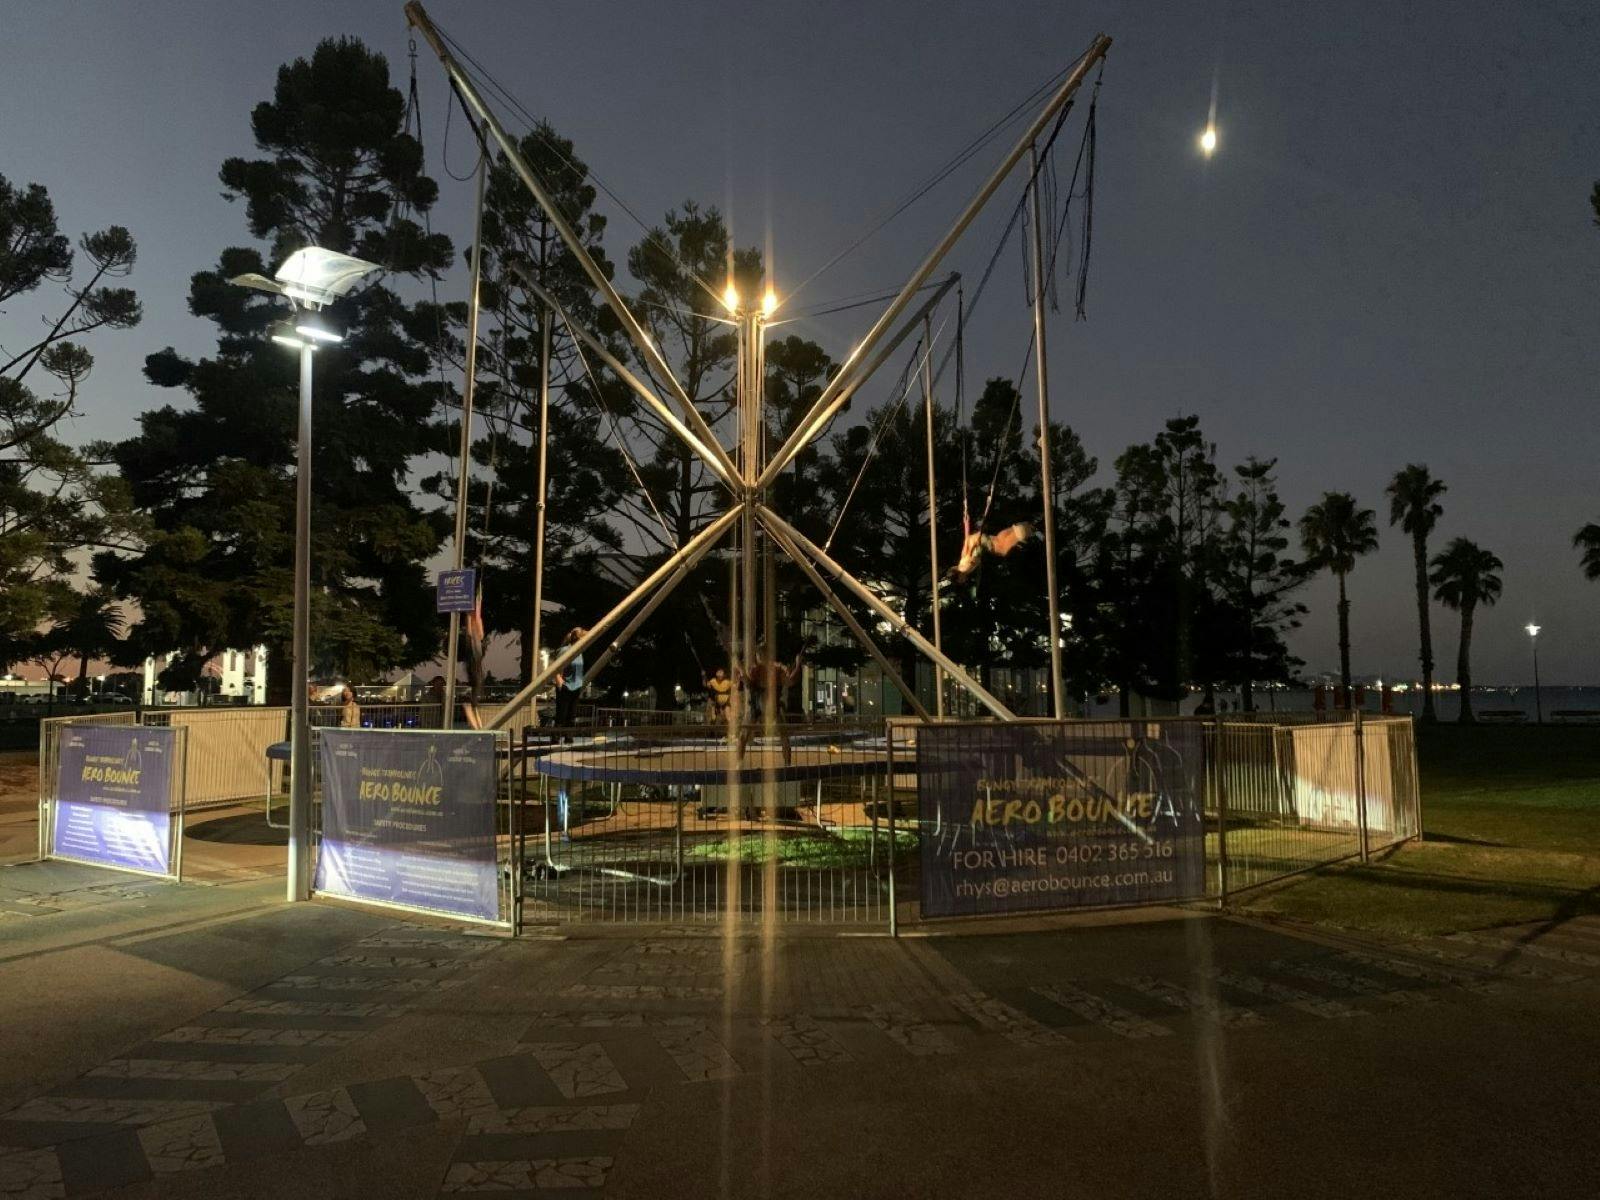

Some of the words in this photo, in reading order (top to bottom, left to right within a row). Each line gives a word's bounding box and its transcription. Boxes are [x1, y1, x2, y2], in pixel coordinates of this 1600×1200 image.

[360, 780, 389, 800] AERO
[391, 782, 443, 805] BOUNCE
[971, 799, 1042, 827] AERO
[1047, 792, 1156, 824] BOUNCE
[954, 850, 996, 870] FOR
[1001, 847, 1047, 867] HIRE
[1055, 843, 1102, 864] 0402
[1107, 842, 1138, 862] 365
[1143, 840, 1173, 859] 516
[956, 870, 1173, 899] rhys@aerobounce.com.au
